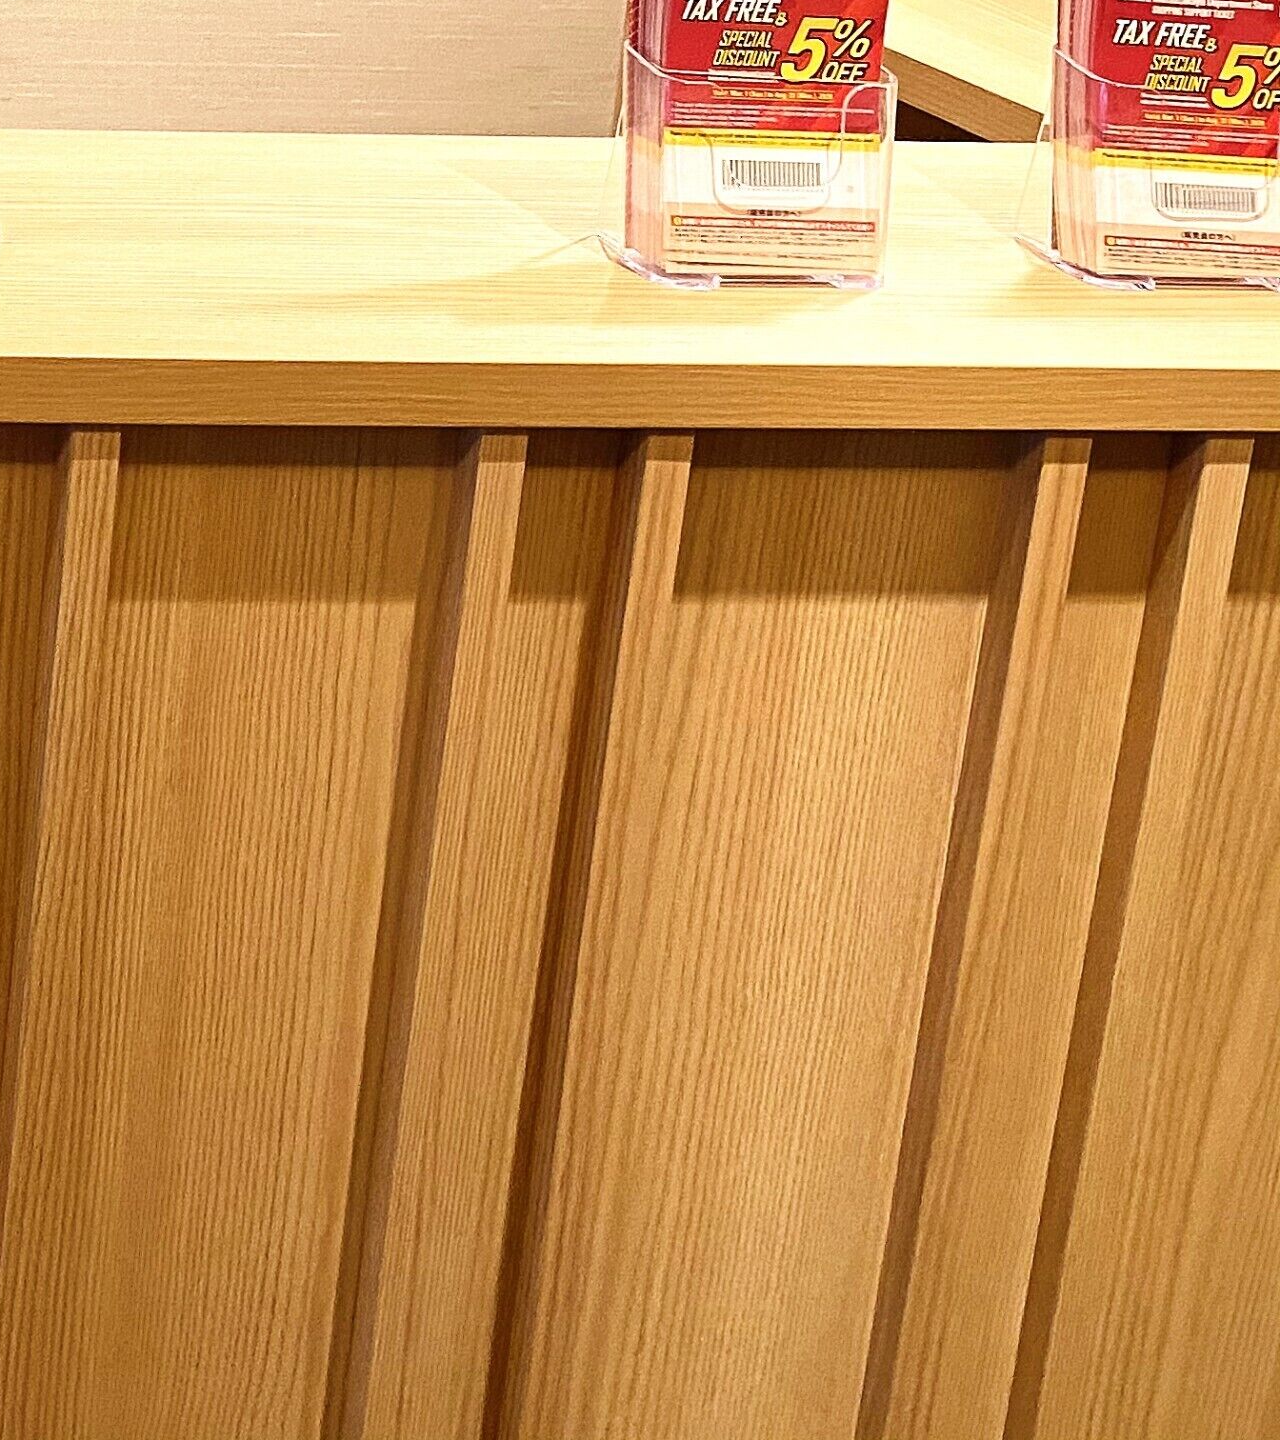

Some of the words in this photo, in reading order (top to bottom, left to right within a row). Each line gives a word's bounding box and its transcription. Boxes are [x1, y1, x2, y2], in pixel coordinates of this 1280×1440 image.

[773, 12, 788, 27] &
[719, 30, 772, 49] SPECIAL
[1112, 19, 1155, 45] TAX
[1155, 21, 1211, 50] FREE
[1205, 36, 1217, 52] &
[713, 50, 781, 68] DISCOUNT
[780, 17, 872, 82] 5%
[821, 61, 868, 82] OFF
[1150, 54, 1203, 74] SPECIAL
[1144, 71, 1209, 93] DISCOUNT
[1252, 88, 1280, 109] OF
